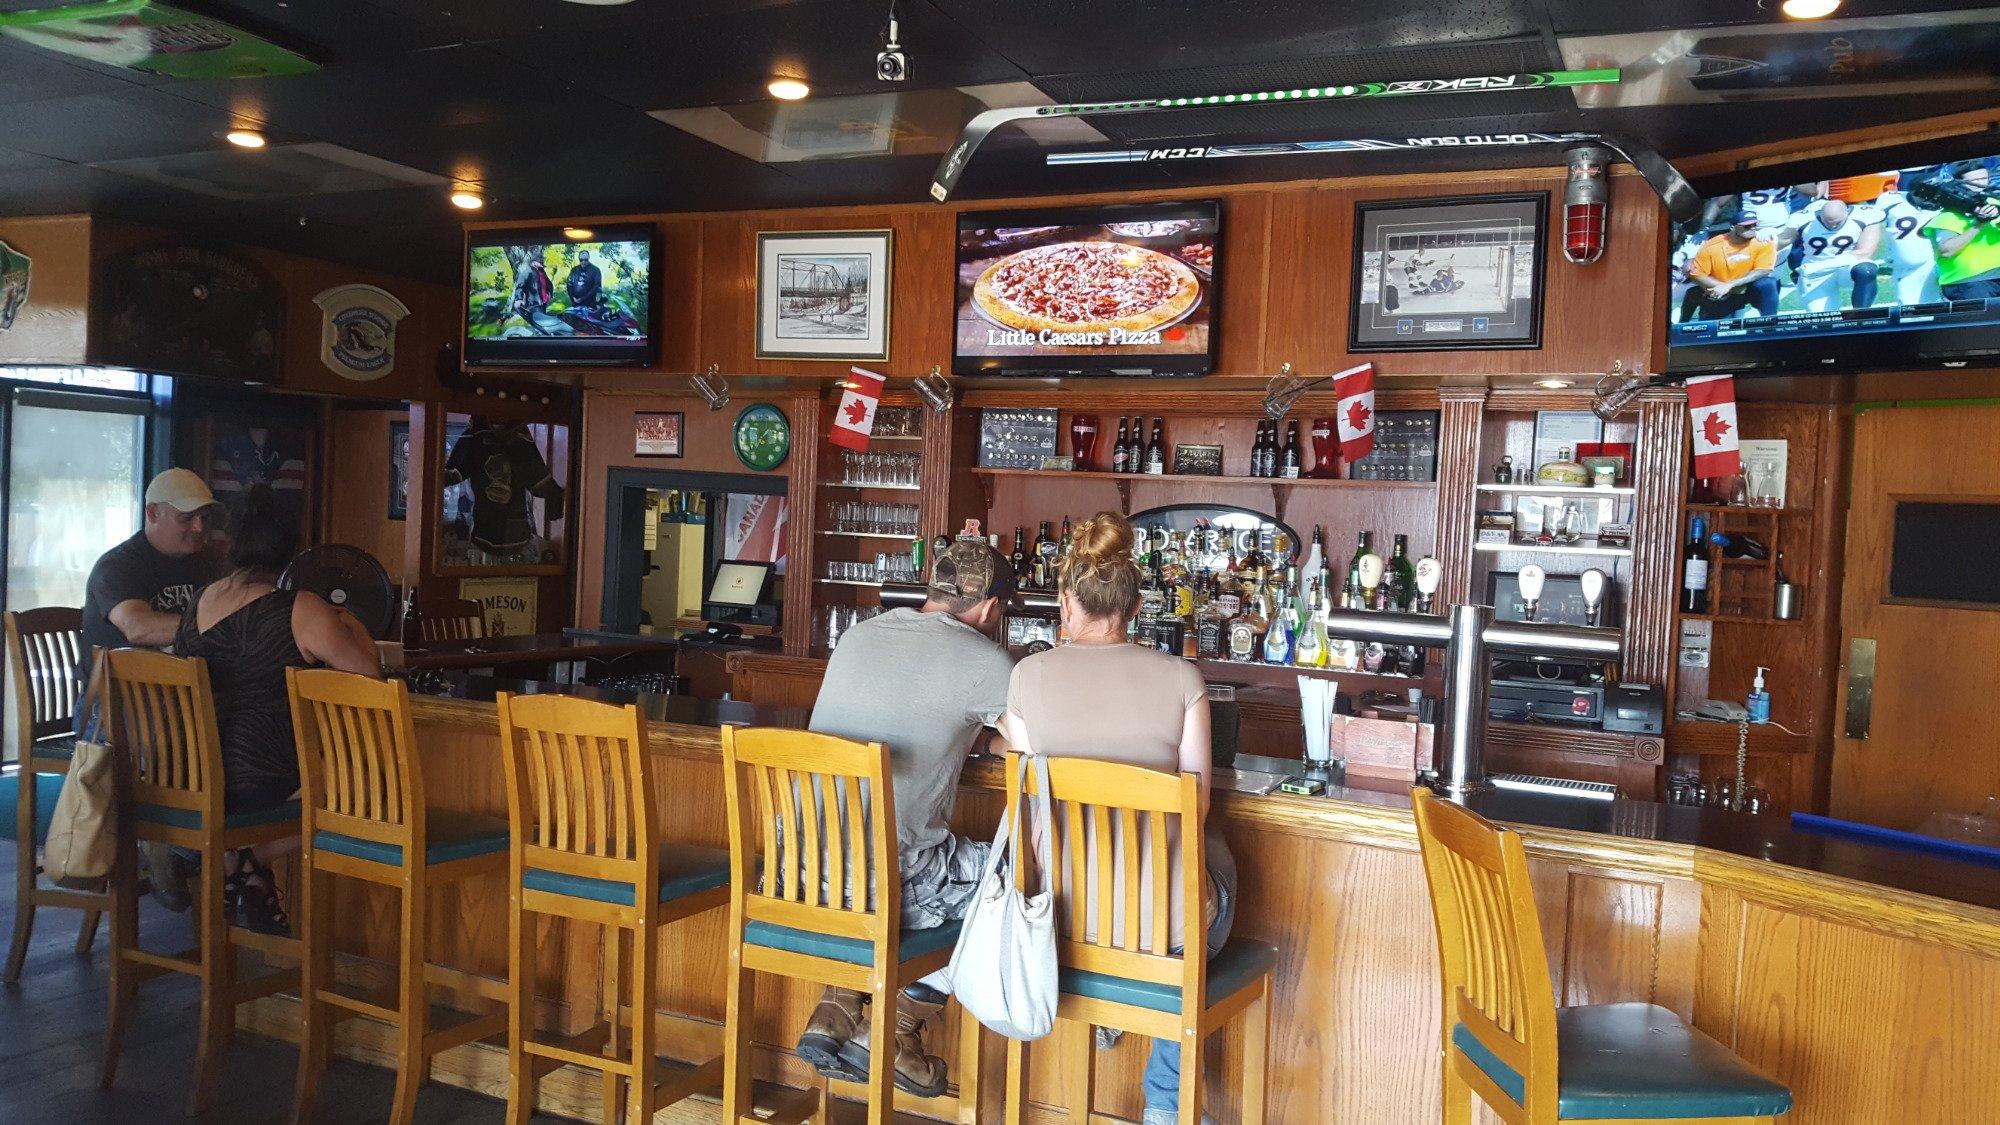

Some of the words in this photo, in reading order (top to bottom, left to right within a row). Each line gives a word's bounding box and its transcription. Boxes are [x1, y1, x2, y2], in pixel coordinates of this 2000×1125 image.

[1407, 136, 1461, 147] GUN
[1464, 134, 1529, 145] OCTO
[1150, 147, 1206, 160] CCM
[1808, 235, 1854, 256] 99
[986, 329, 1036, 346] Little
[1039, 328, 1104, 346] Caesars
[1107, 328, 1162, 345] Pizza
[484, 595, 527, 613] MESON
